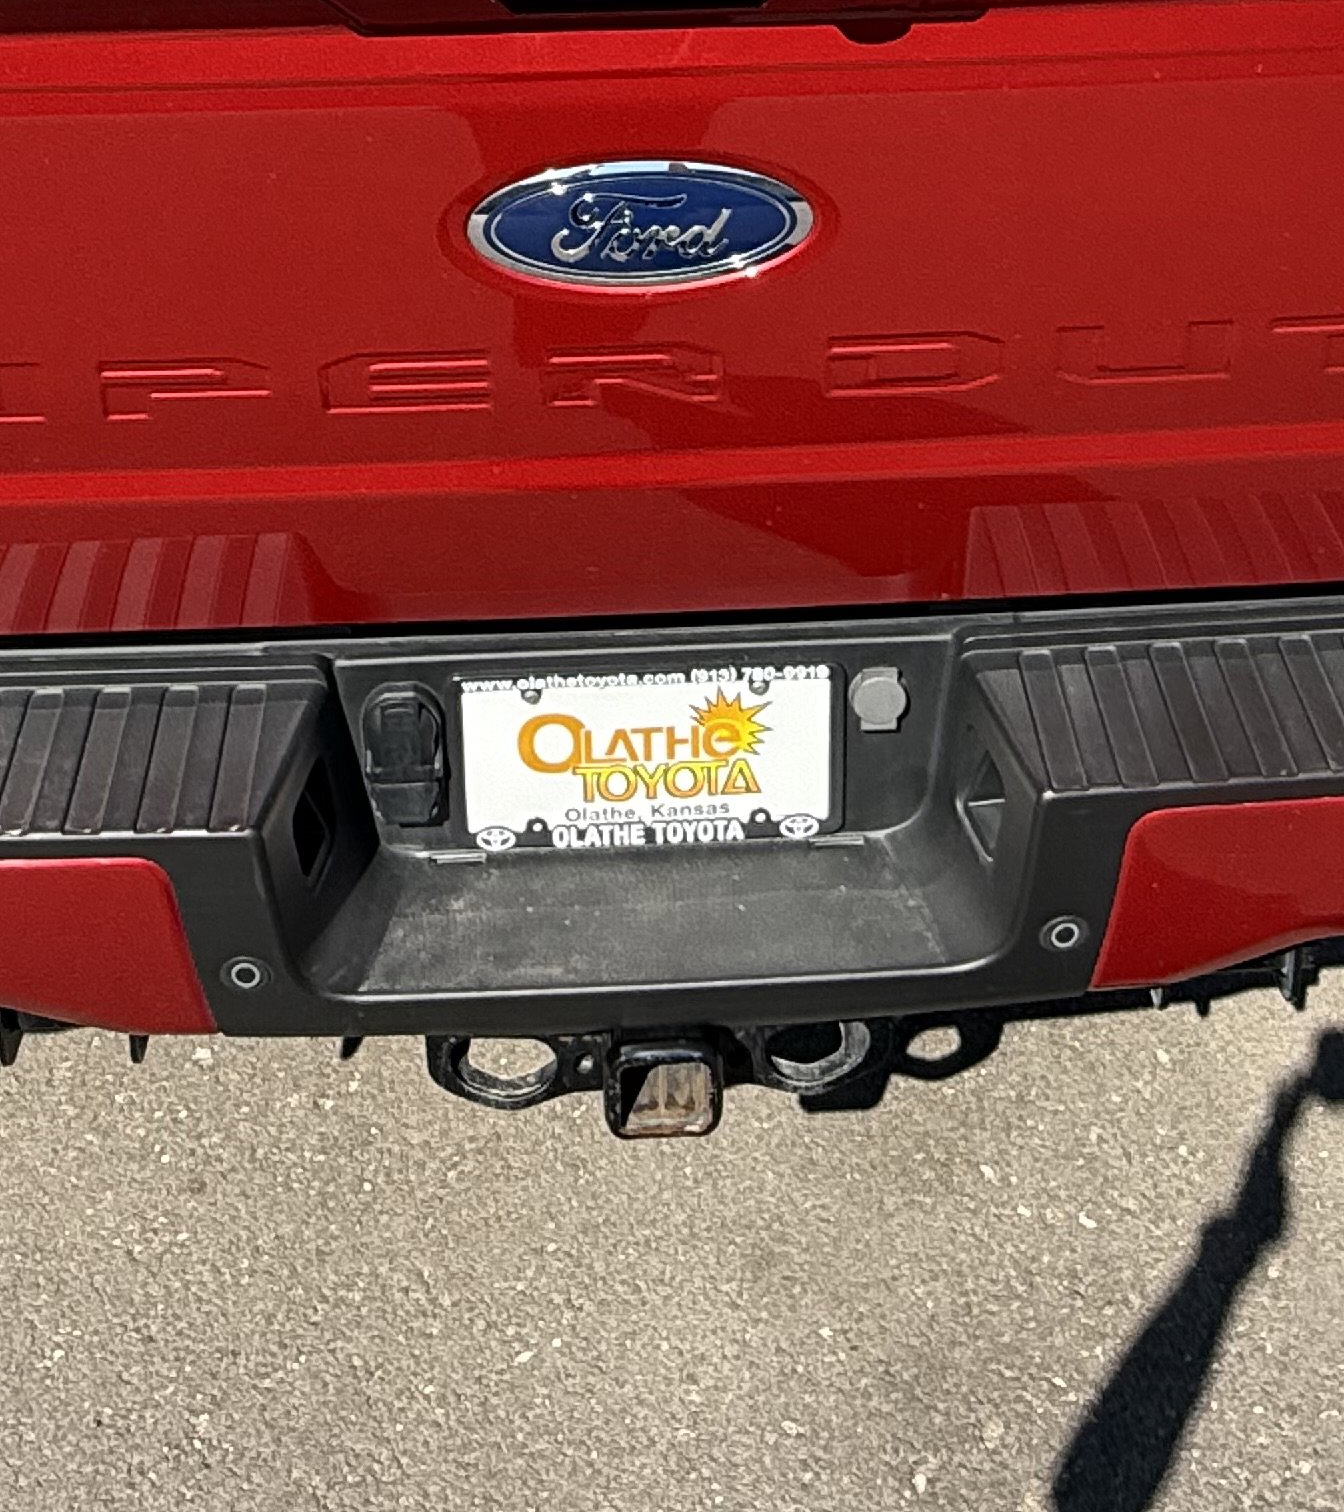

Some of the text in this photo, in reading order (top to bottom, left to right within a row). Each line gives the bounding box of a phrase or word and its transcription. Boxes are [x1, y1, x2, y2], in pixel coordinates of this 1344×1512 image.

[551, 192, 732, 262] Ford
[572, 758, 762, 803] TOYOTA
[565, 802, 731, 824] Olathe, Kansas
[552, 819, 745, 849] OLATHE TOYOTA
